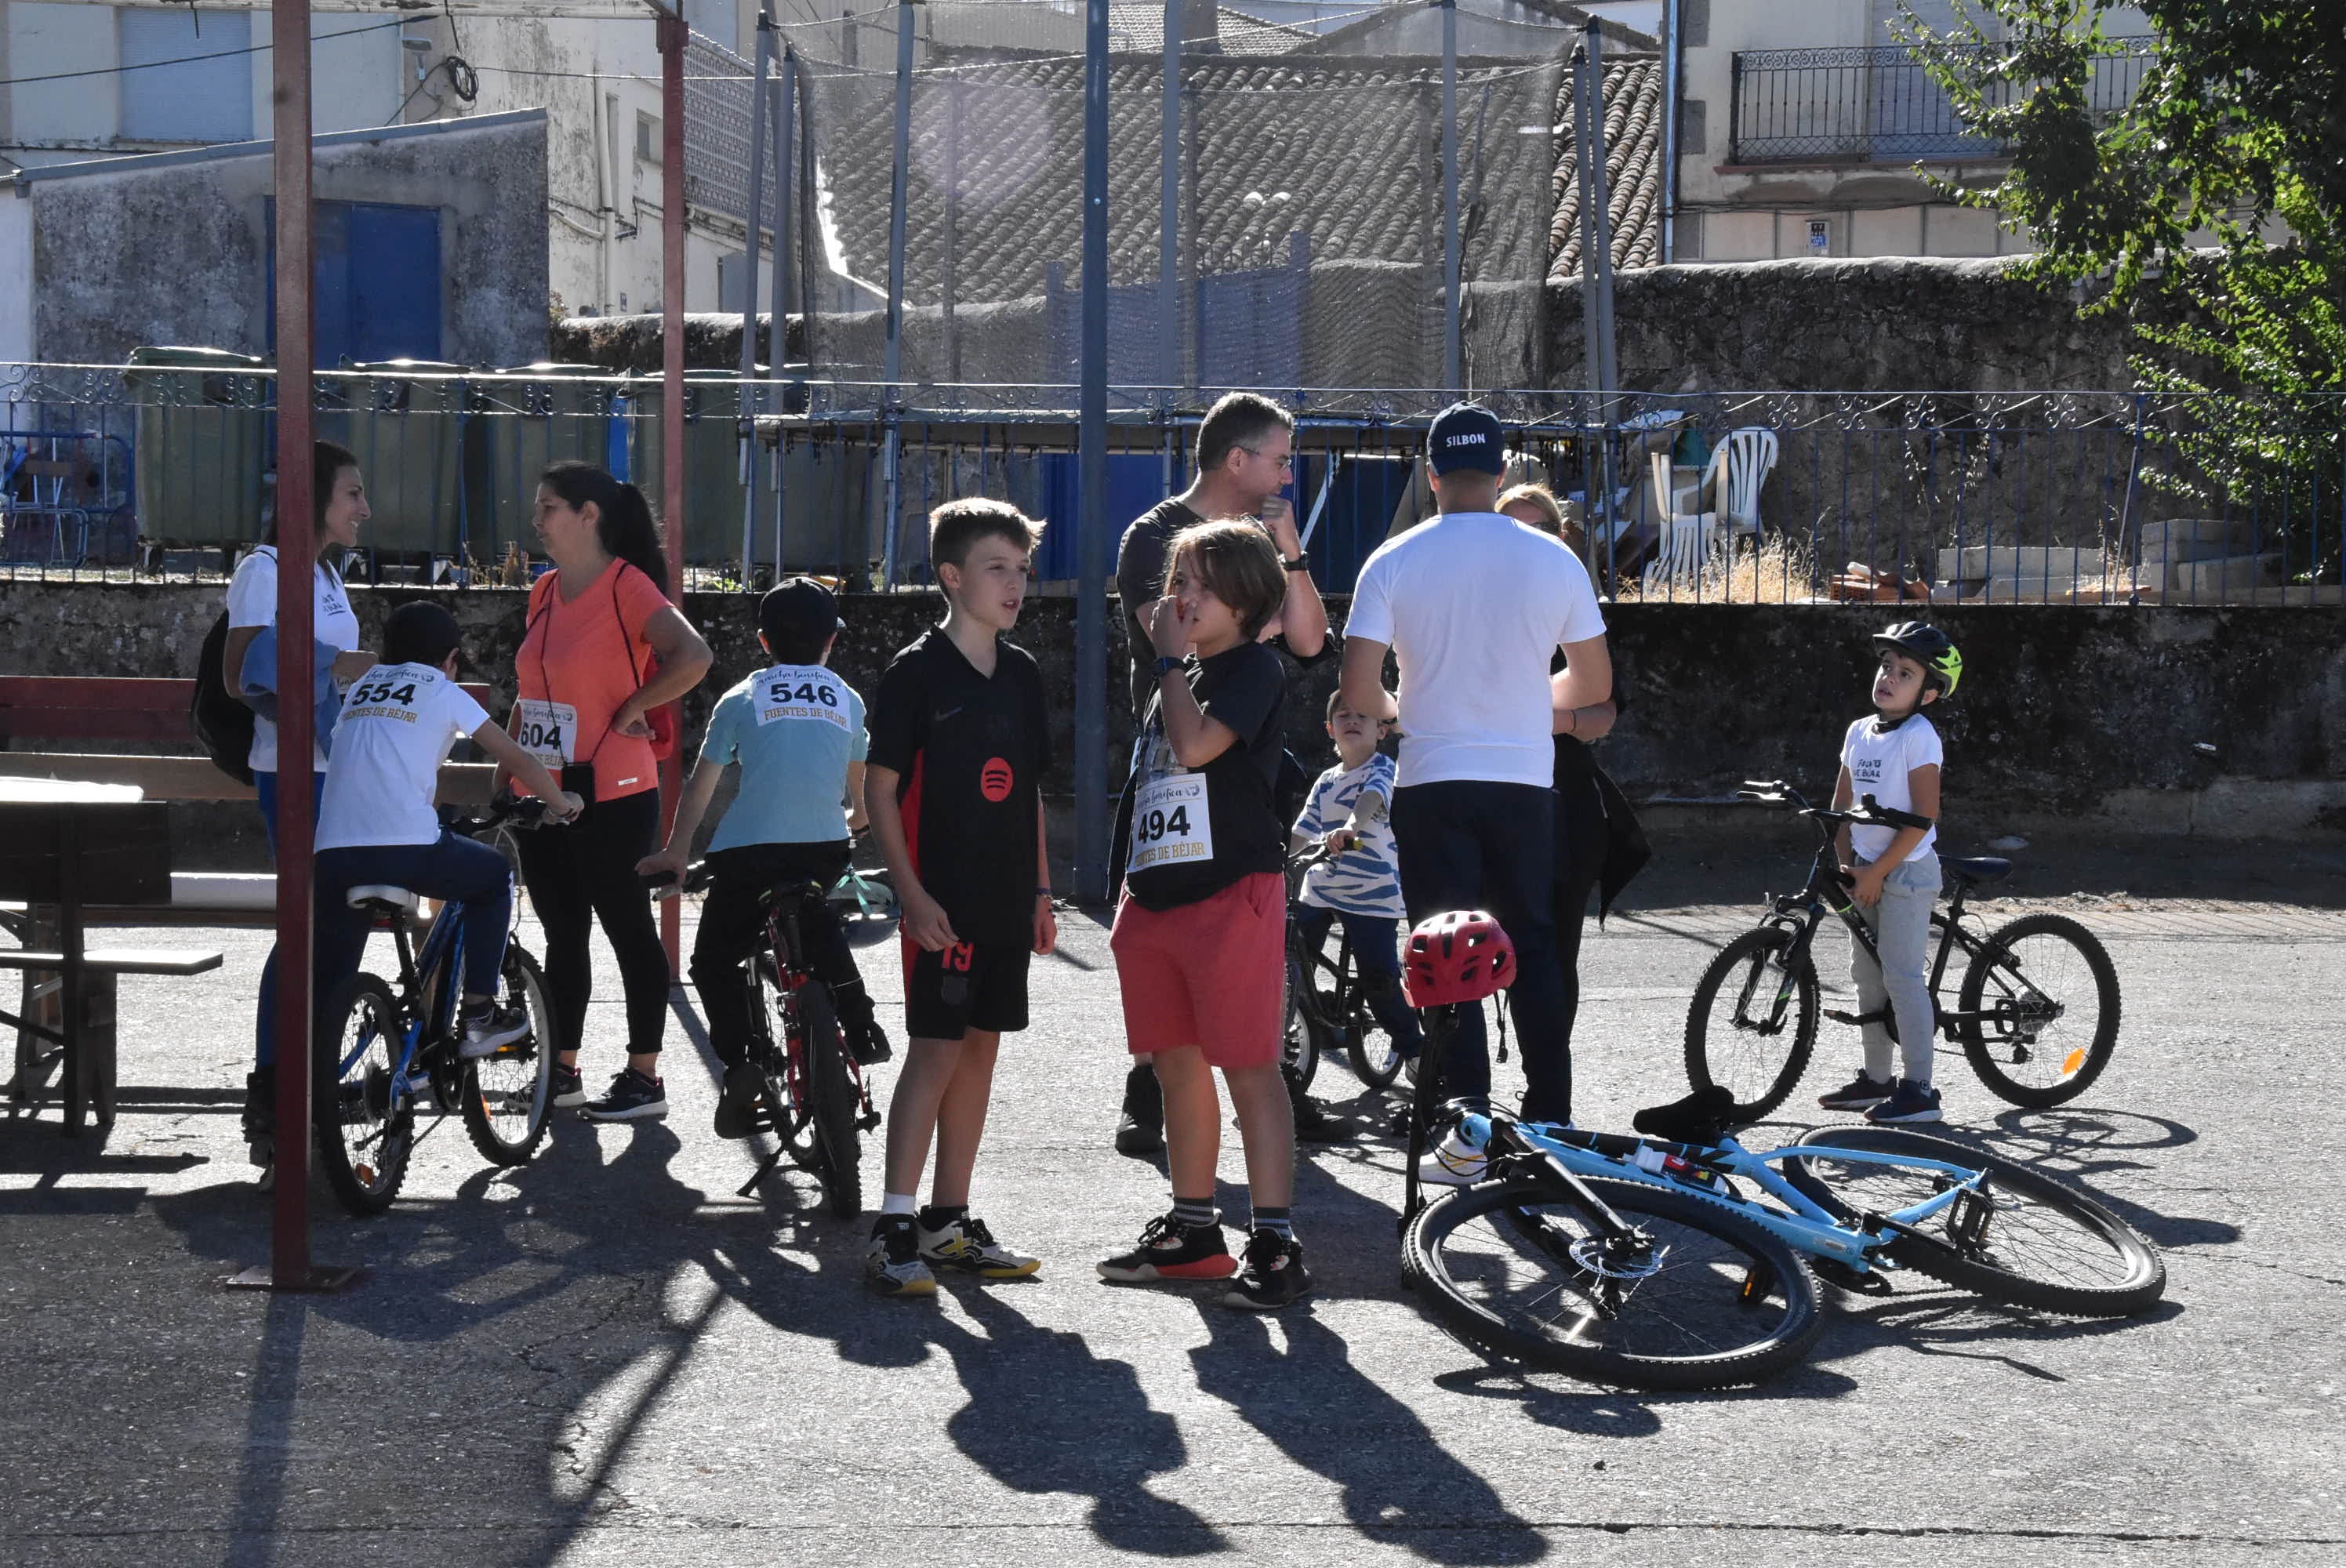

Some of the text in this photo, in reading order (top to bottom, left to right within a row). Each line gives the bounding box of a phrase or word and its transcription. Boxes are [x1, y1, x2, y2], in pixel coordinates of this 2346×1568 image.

[1445, 433, 1487, 448] SILBON
[351, 682, 416, 706] 554
[771, 683, 838, 708] 546
[764, 706, 808, 721] FUENTES
[808, 707, 823, 717] DE
[520, 721, 561, 750] 604
[1138, 804, 1191, 844] 494
[1157, 845, 1171, 861] DE
[1171, 840, 1205, 858] BÉJAR
